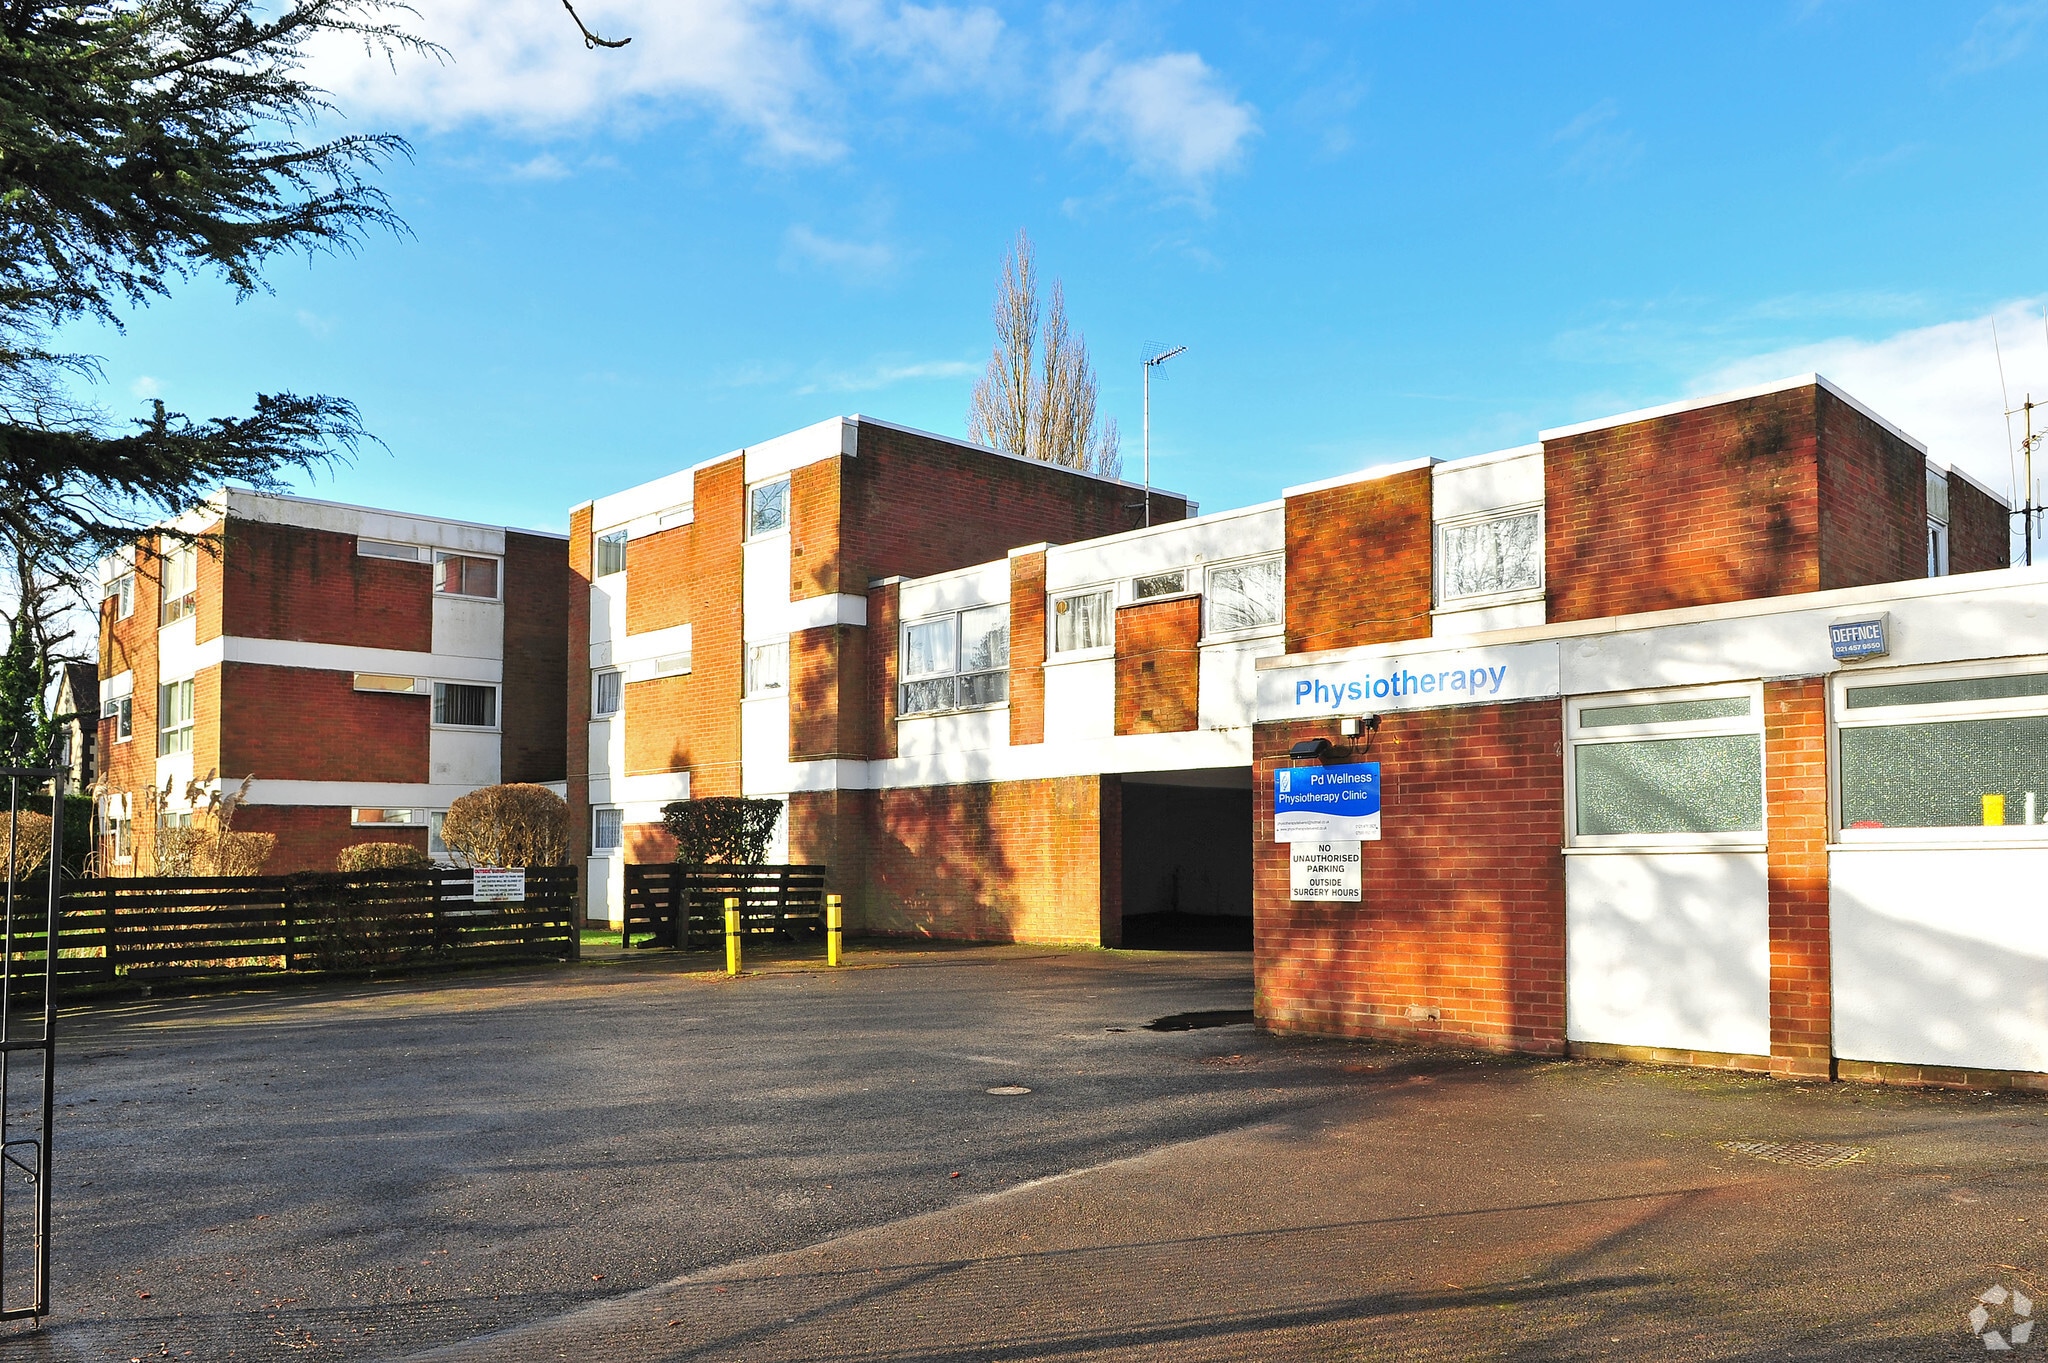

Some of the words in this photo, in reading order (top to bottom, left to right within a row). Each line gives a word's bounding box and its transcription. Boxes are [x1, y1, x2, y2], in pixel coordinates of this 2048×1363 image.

[1296, 665, 1507, 709] Physiotherapy
[1311, 775, 1324, 785] Pd
[1327, 773, 1372, 784] Wellness
[1279, 793, 1339, 805] Physiotherapy
[1342, 790, 1367, 800] Clinic
[1318, 844, 1331, 852] NO
[1307, 865, 1344, 873] PARKING
